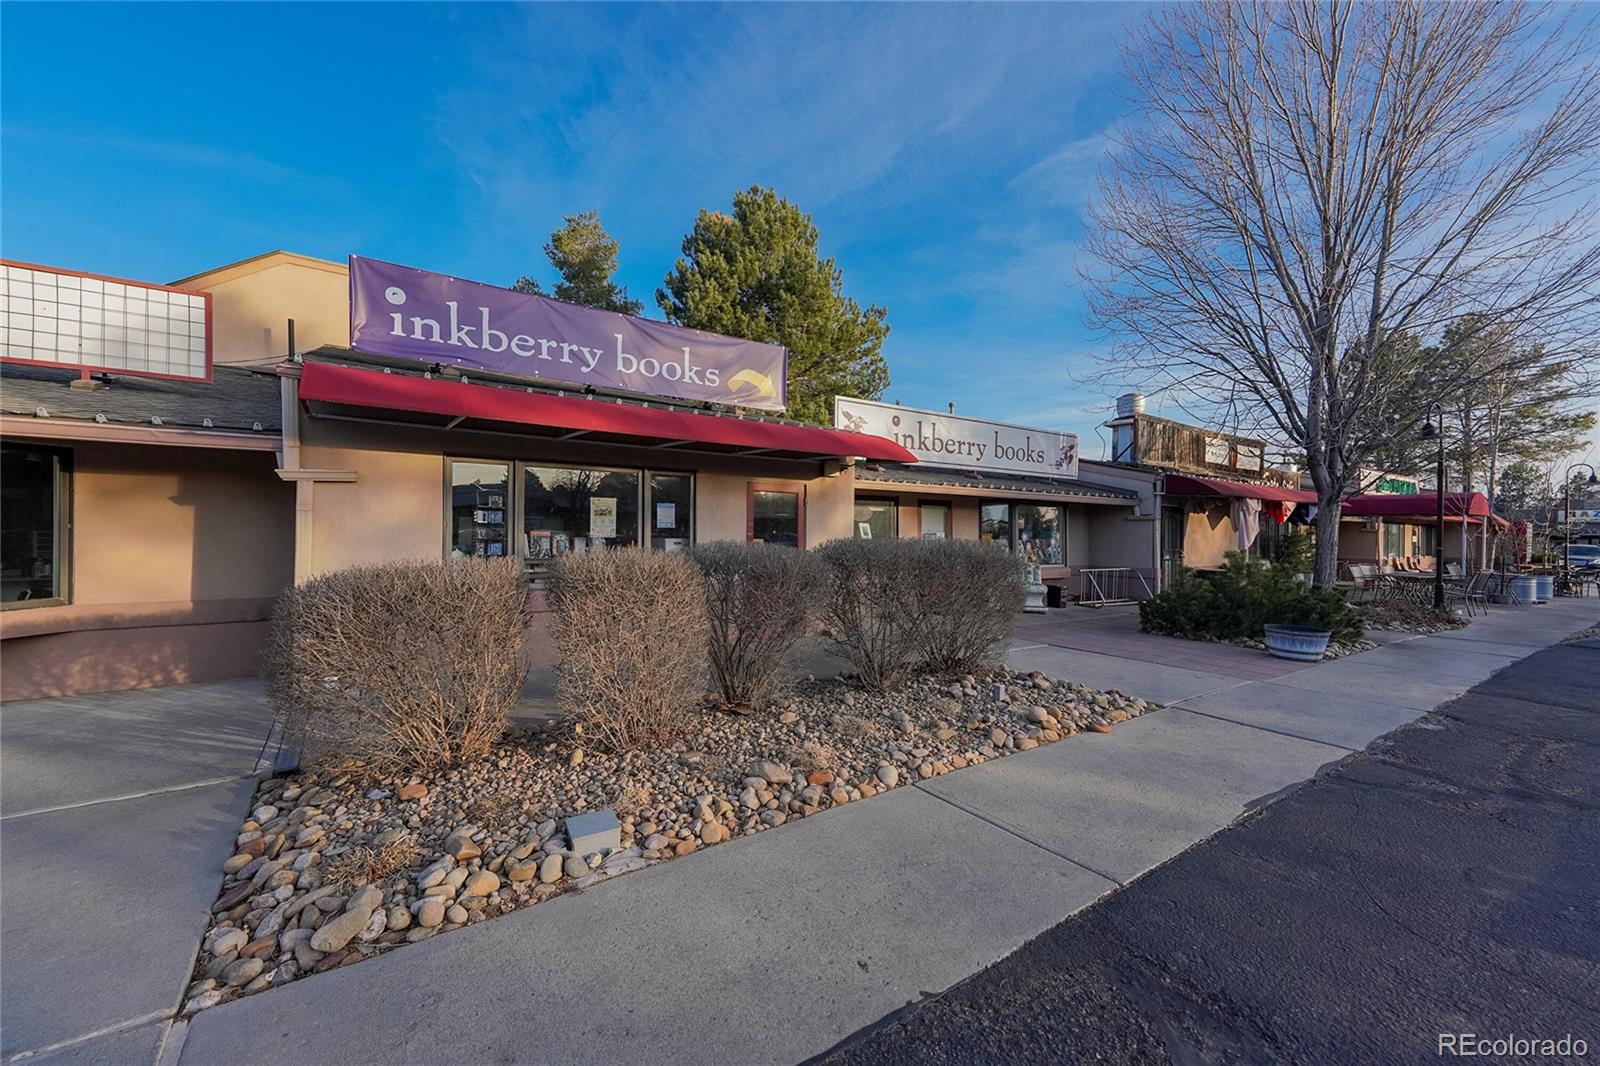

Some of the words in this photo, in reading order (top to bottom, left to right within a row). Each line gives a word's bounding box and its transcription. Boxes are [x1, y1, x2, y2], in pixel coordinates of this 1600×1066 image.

[385, 286, 604, 374] inkberry
[614, 333, 720, 387] books
[892, 415, 987, 462] inkberry
[994, 431, 1045, 464] books
